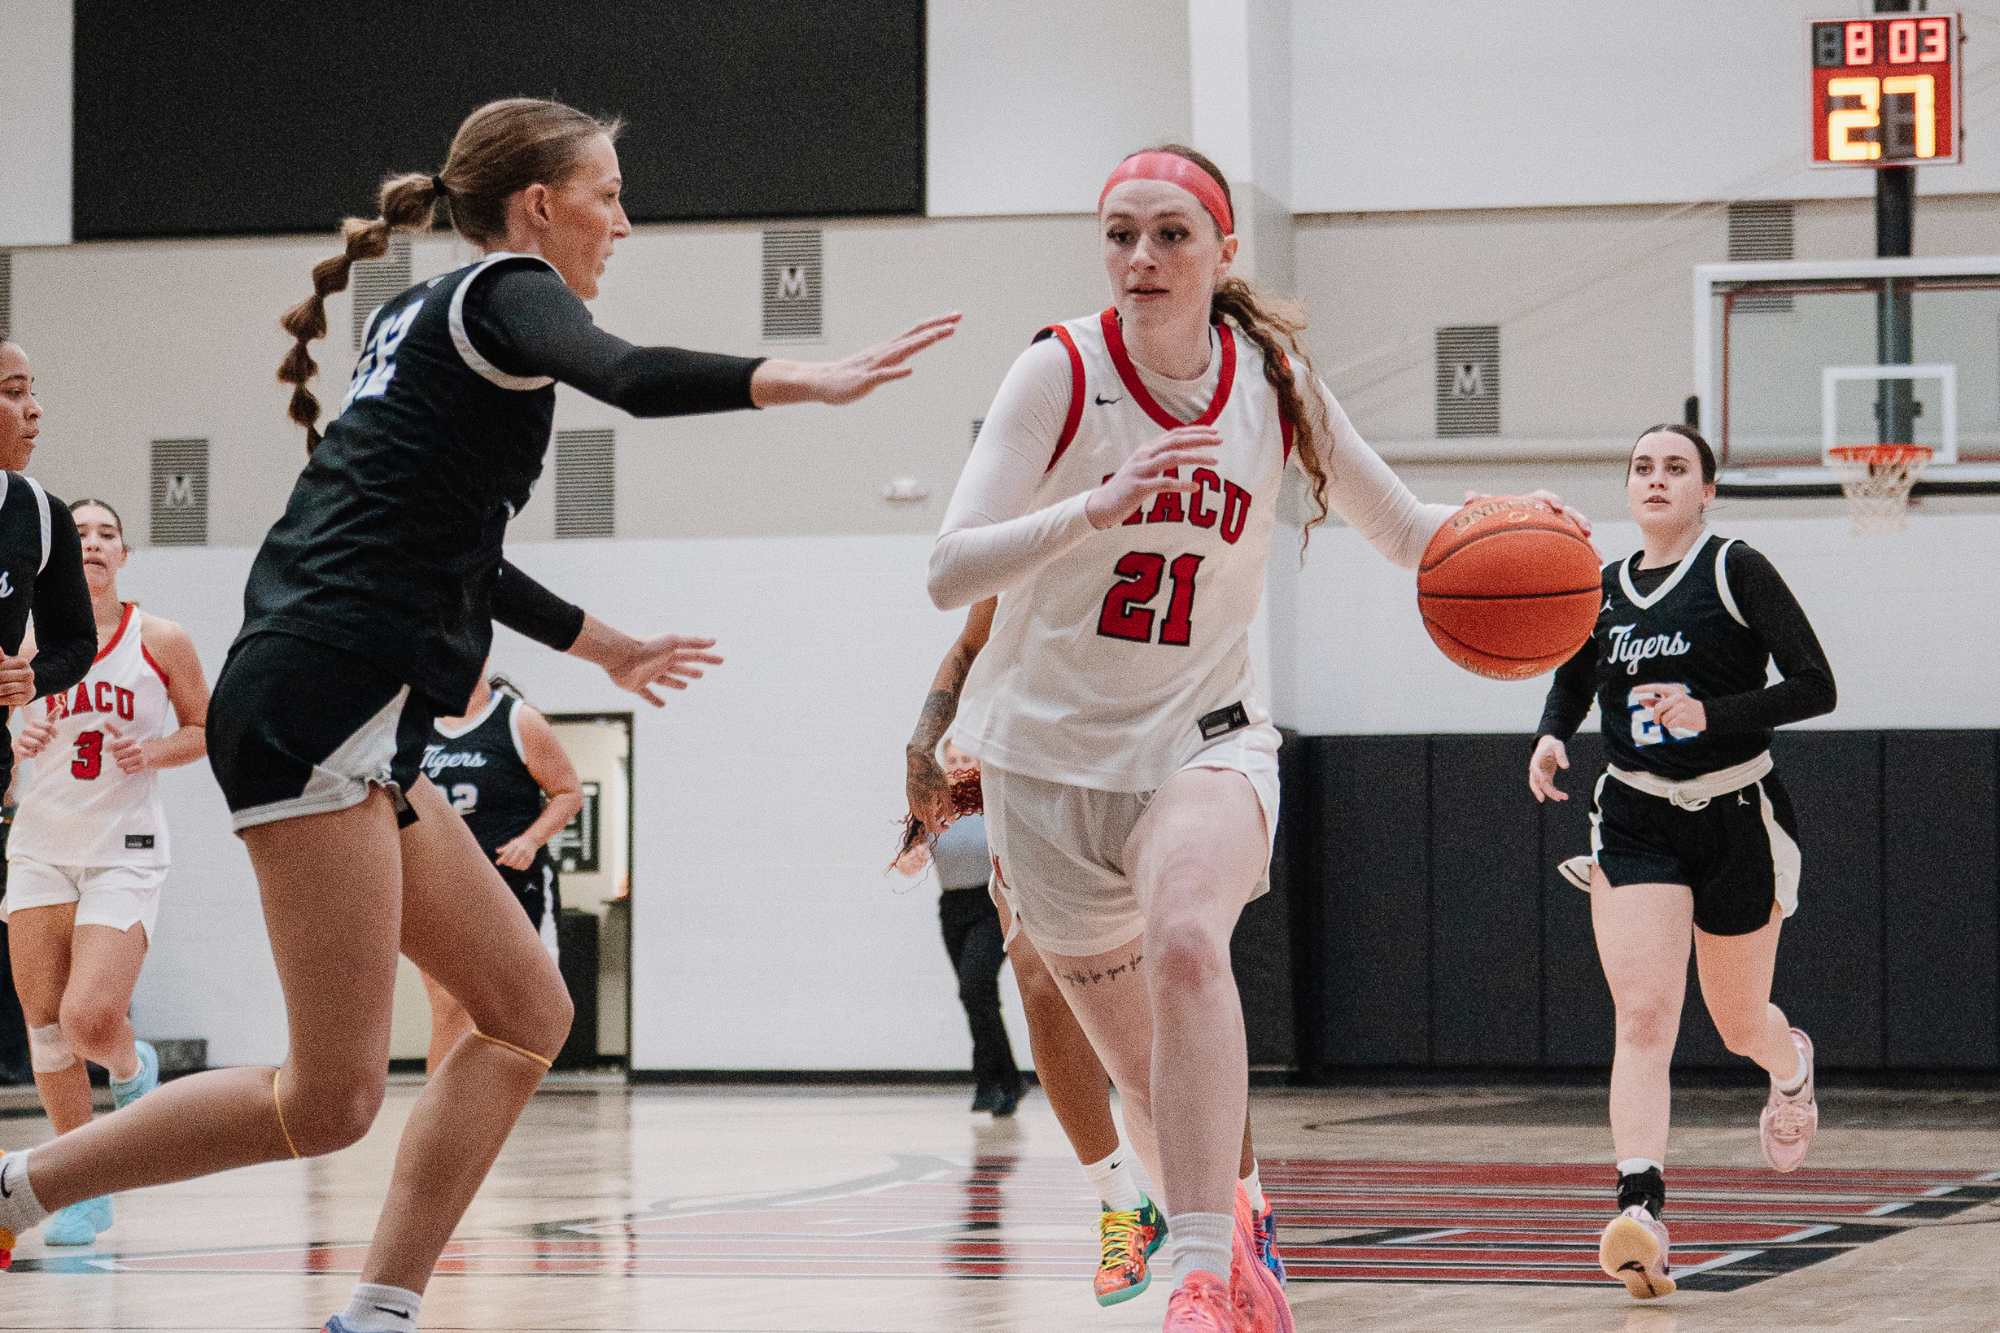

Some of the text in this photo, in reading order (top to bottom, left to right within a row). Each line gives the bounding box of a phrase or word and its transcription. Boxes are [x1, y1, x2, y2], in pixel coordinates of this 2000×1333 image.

[1827, 75, 1936, 161] 27
[777, 266, 807, 300] M
[1452, 363, 1484, 397] M
[166, 475, 195, 505] M
[1102, 467, 1252, 545] ACU
[1096, 551, 1205, 647] 21
[1607, 623, 1690, 675] Tigers
[1627, 682, 1701, 748] 2
[71, 730, 104, 780] 3
[419, 744, 488, 778] Tigers
